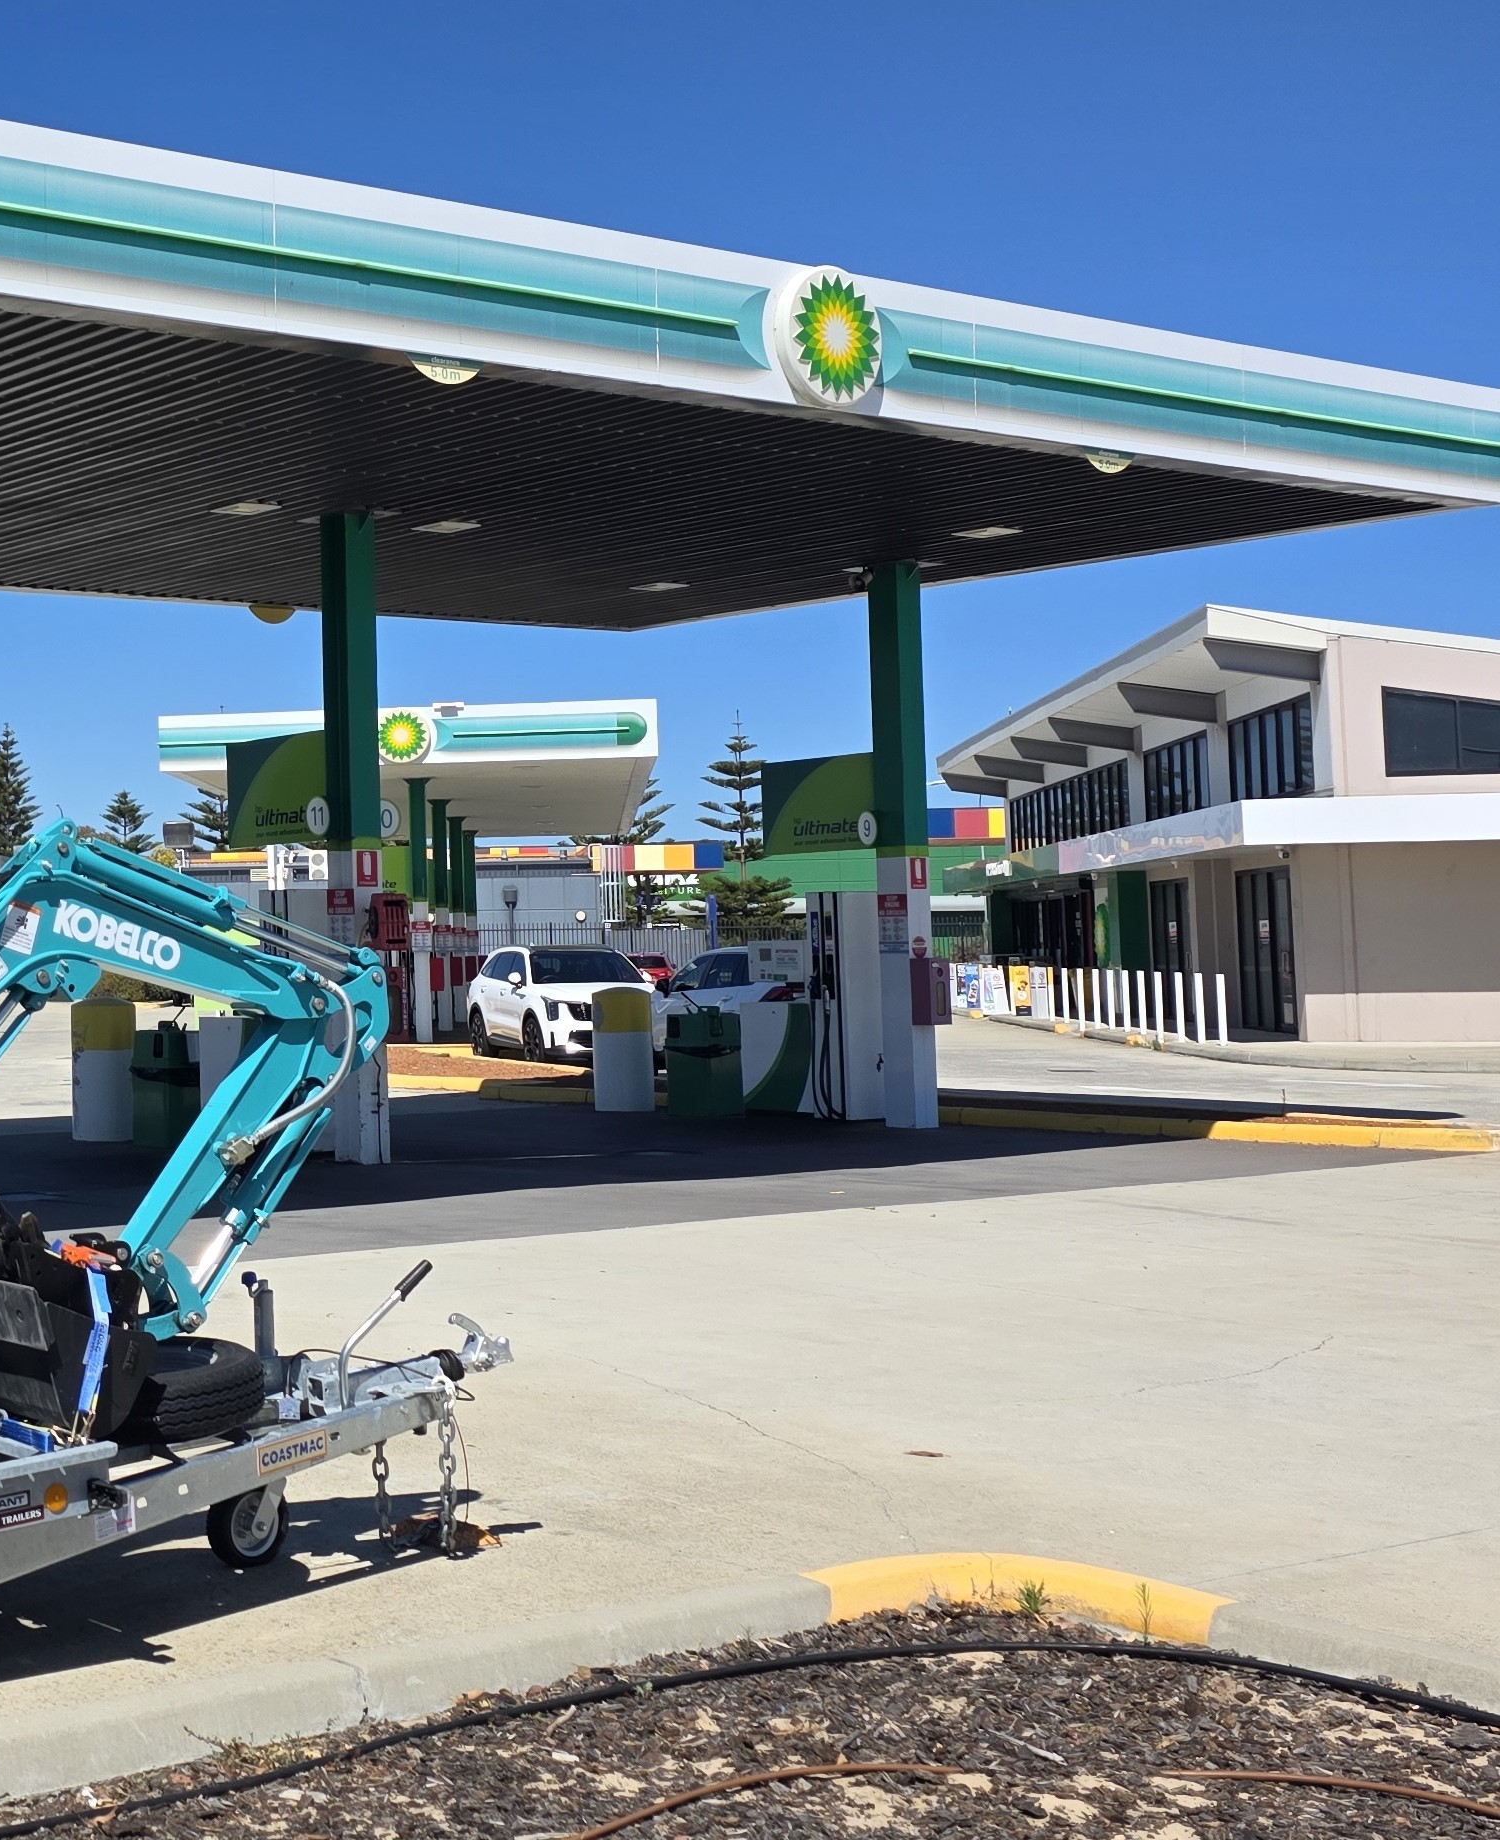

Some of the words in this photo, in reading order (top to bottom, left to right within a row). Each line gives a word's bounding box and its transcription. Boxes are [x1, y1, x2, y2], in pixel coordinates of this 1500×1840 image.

[310, 806, 325, 827] 11
[793, 818, 858, 837] ultimate
[863, 819, 871, 837] 9
[52, 899, 181, 970] KOBELCO
[261, 1436, 324, 1467] COASTMAC
[1, 1508, 43, 1527] TRAILERS
